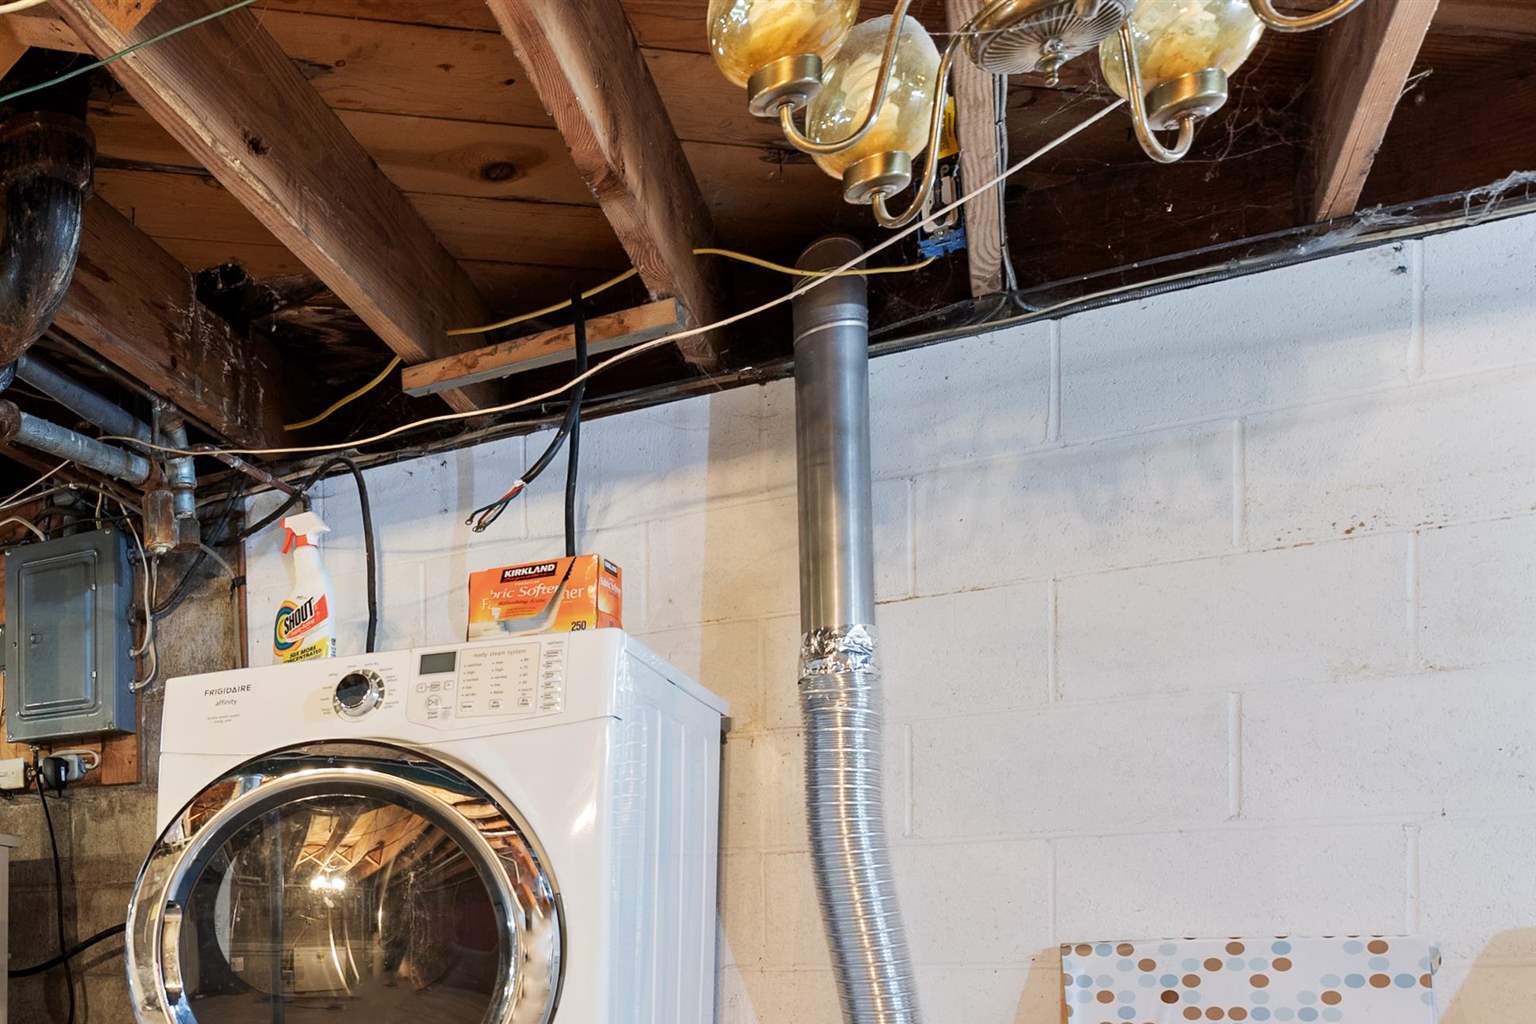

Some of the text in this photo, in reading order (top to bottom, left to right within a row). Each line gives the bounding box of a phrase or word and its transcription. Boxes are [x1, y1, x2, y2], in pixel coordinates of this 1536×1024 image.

[504, 564, 556, 578] KIRKLAND
[284, 596, 314, 635] SHOUT
[571, 621, 586, 632] 250
[204, 684, 252, 697] FRIGIDAIRE
